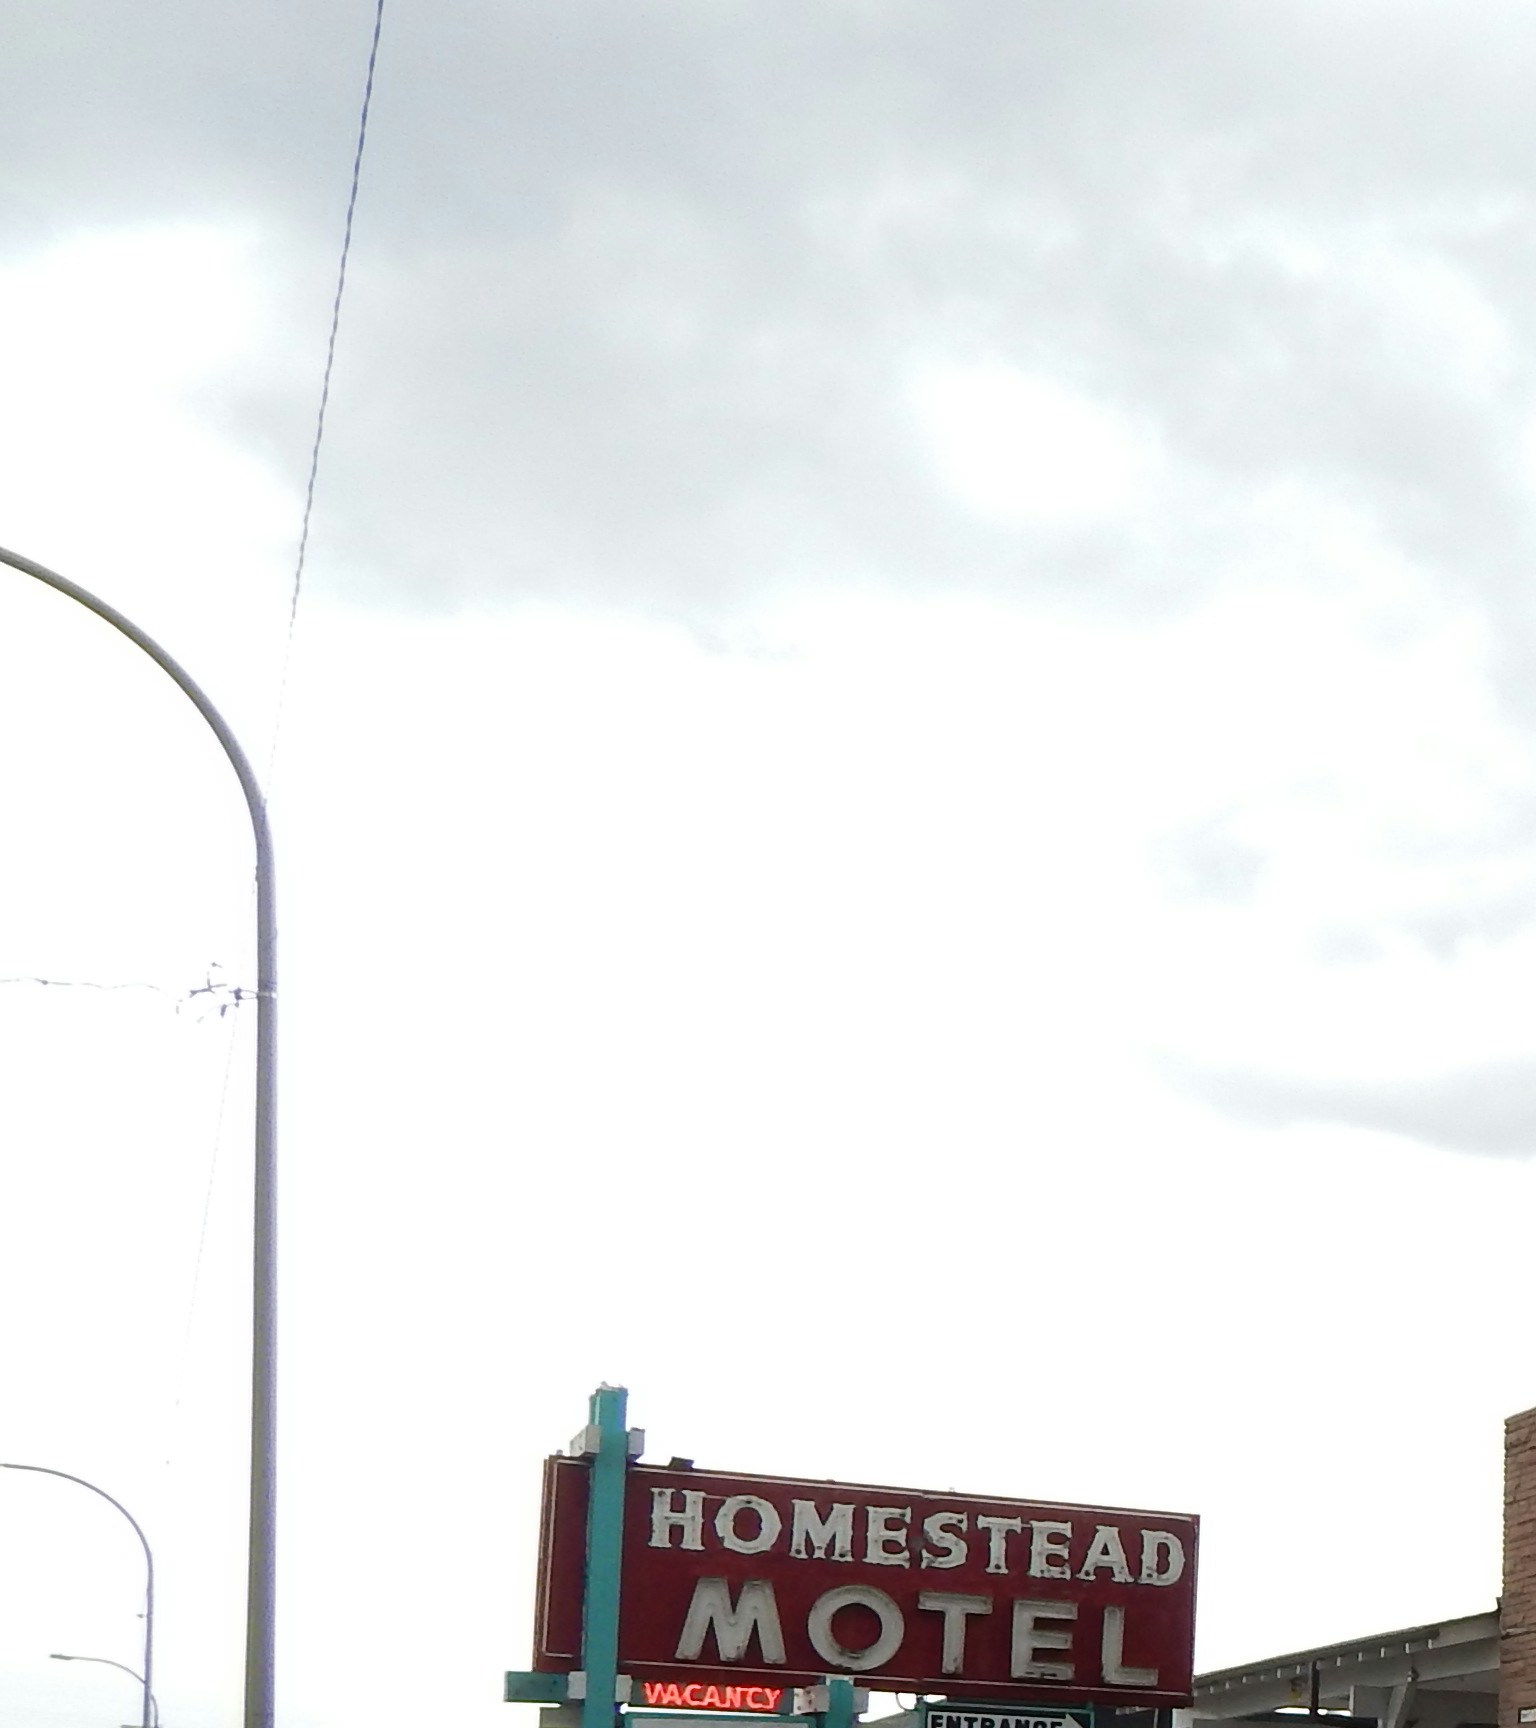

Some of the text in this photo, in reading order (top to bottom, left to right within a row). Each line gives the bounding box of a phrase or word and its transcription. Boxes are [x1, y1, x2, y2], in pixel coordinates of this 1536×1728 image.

[648, 1487, 1186, 1587] HOMESTEAD
[674, 1577, 1158, 1686] MOTEL
[643, 1682, 781, 1709] VACANCY
